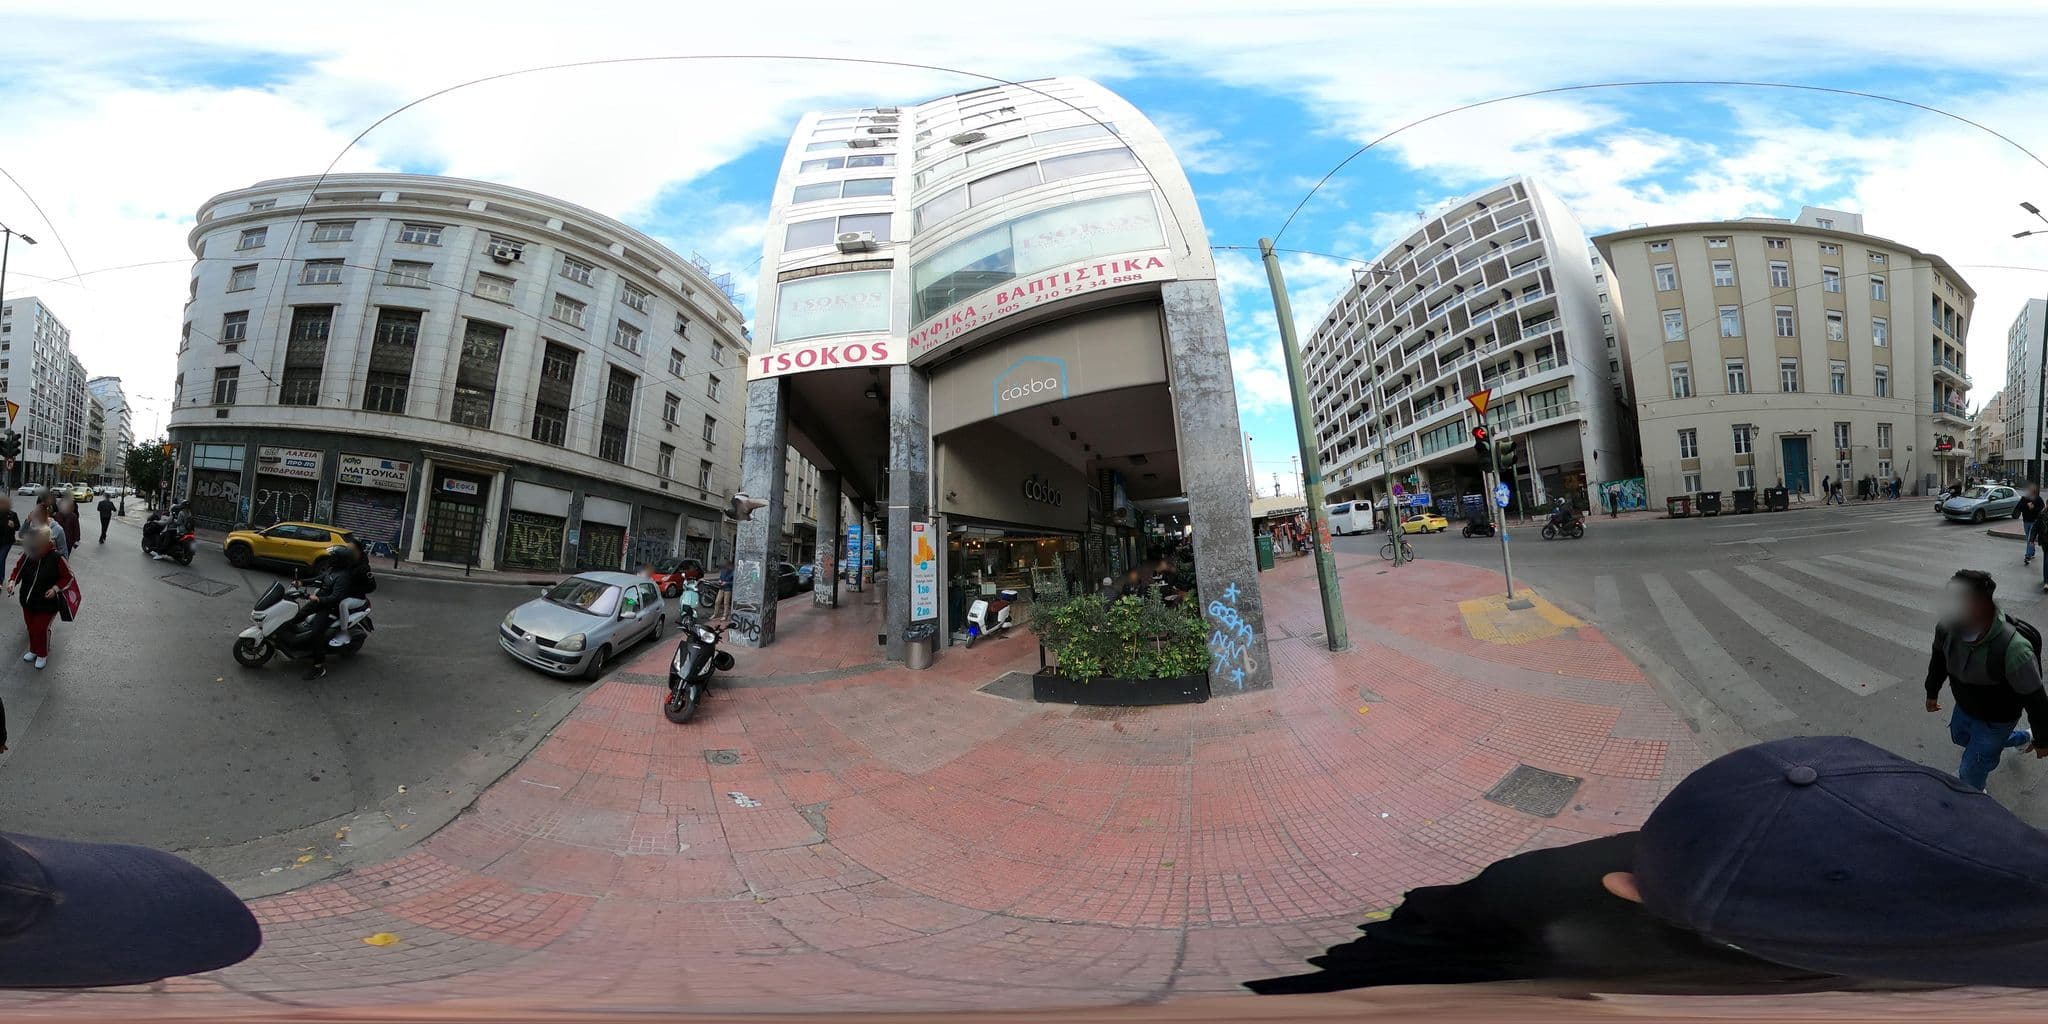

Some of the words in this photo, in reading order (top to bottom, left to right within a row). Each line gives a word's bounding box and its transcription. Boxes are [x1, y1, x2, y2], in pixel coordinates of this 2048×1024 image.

[1035, 291, 1059, 303] 210
[1065, 284, 1083, 294] 52
[1089, 279, 1107, 288] 34
[1113, 273, 1142, 284] 888
[910, 306, 976, 349] ΝΥΦΙΚΑ
[996, 257, 1164, 305] ΒΑΠΤΙΣΤΙΚΑ
[760, 342, 888, 374] TSOKOS
[1001, 378, 1057, 401] casba
[286, 450, 318, 458] ΛΑΧΕΙΑ
[259, 465, 316, 477] ΙΠΠΟΔΡΟΜΟΣ
[343, 466, 405, 481] ΜΑΤΣΟΥΚΑΣ
[1025, 480, 1063, 506] casba
